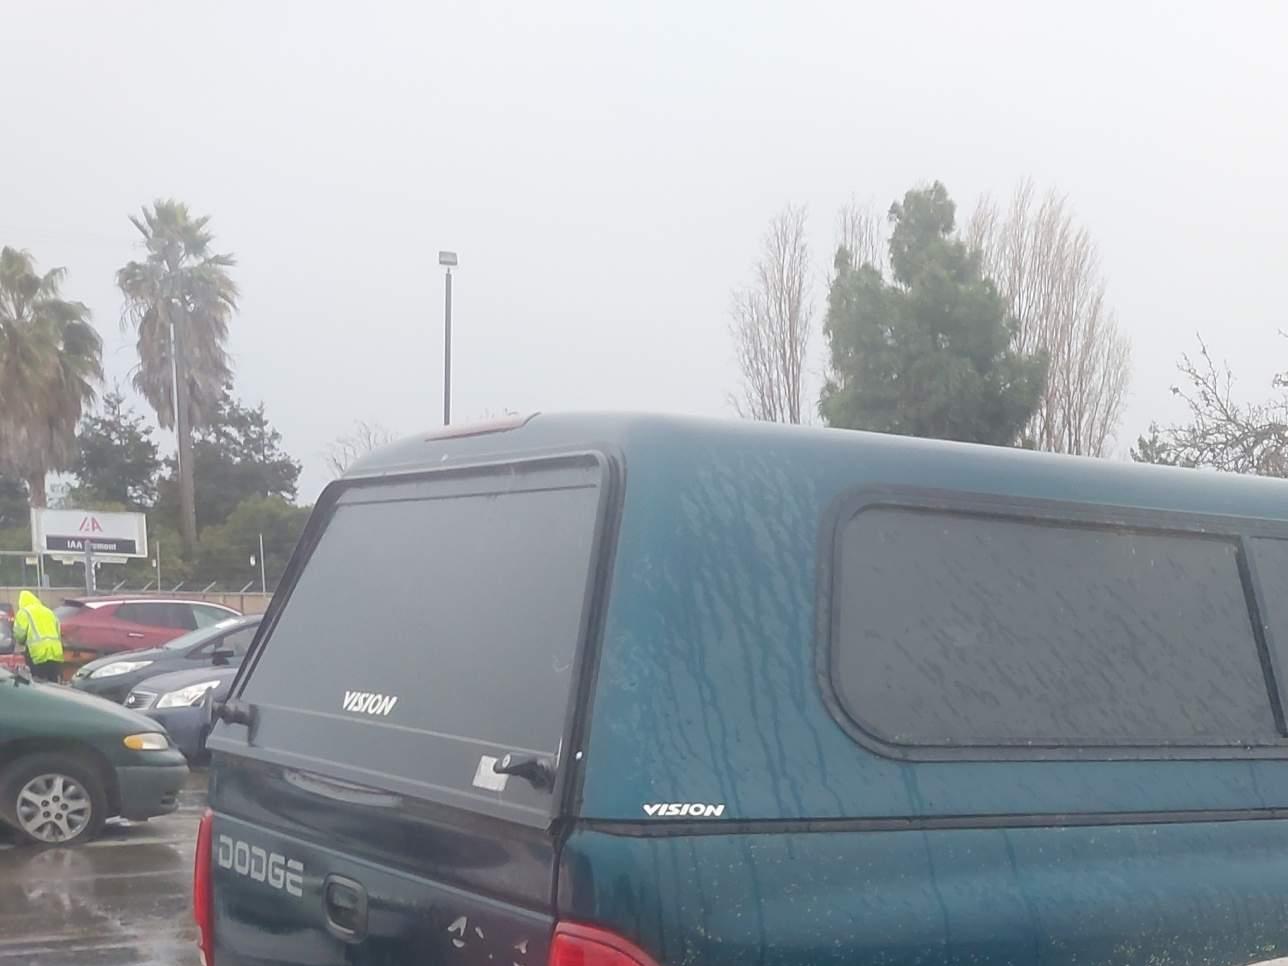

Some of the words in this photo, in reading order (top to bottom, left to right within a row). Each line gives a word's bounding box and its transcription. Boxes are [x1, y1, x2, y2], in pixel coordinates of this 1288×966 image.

[67, 540, 83, 549] IAA
[342, 690, 397, 715] VISION
[643, 802, 725, 817] VISION
[219, 836, 303, 896] DODGE
